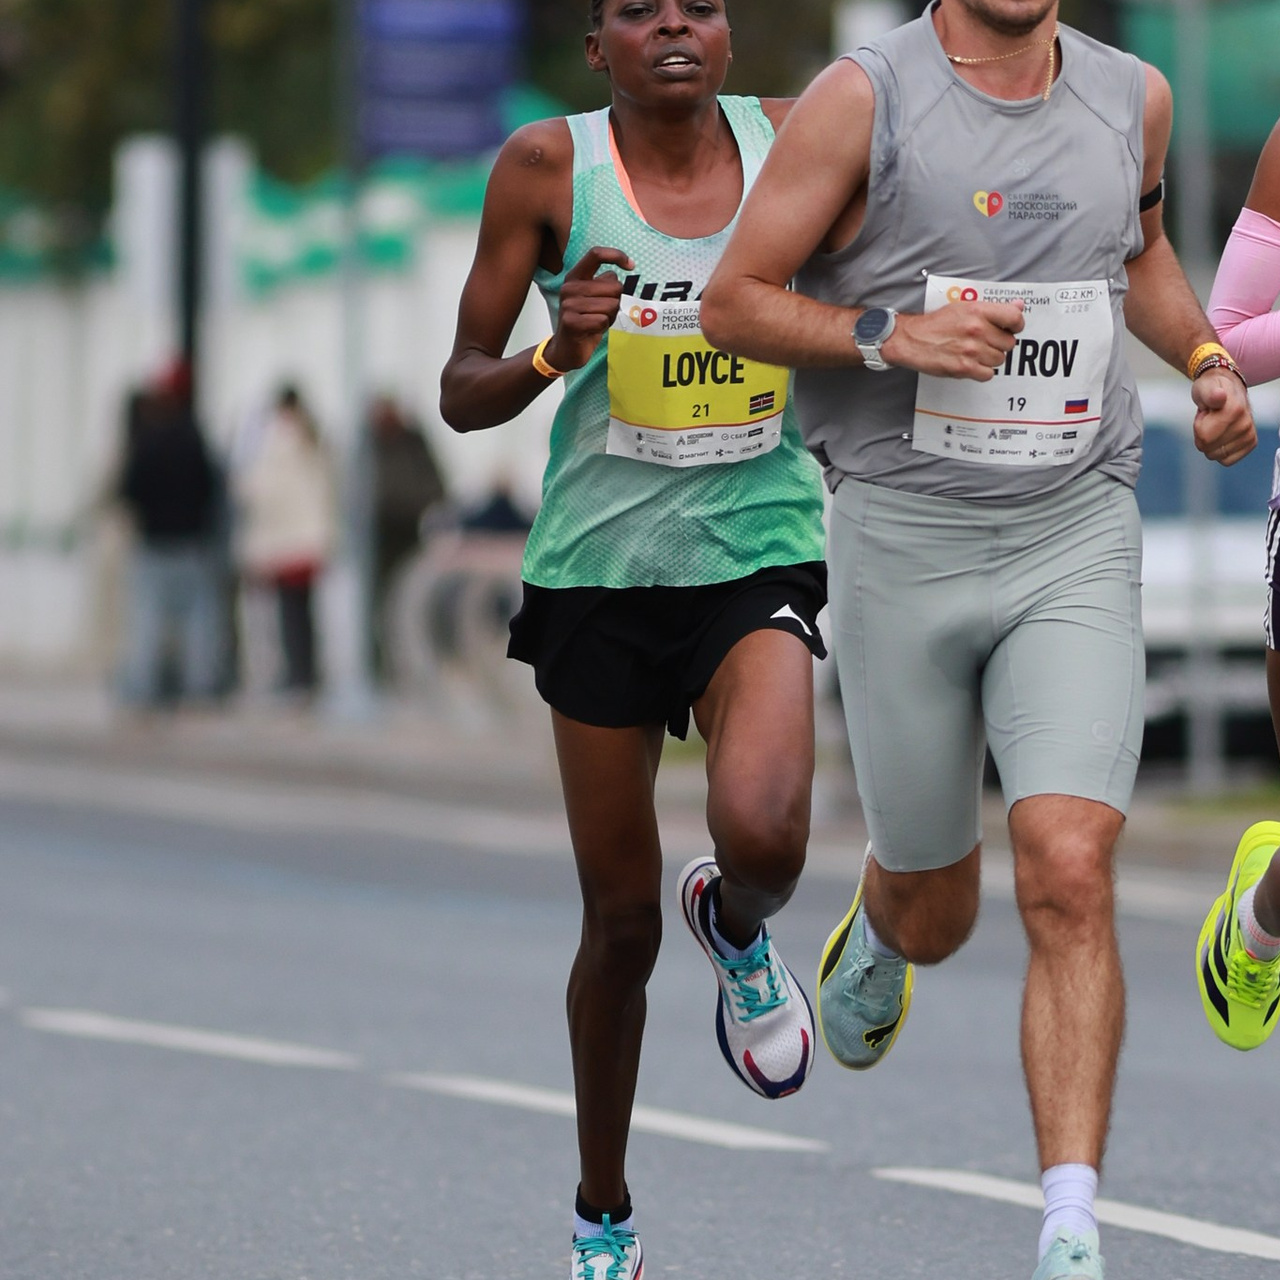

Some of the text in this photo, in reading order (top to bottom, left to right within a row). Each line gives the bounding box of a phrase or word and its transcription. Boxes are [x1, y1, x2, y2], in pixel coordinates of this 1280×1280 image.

[1008, 201, 1077, 211] МОСКОВСКИЙ
[1008, 211, 1059, 220] МАРАФОН
[984, 288, 1033, 296] СБЕРПРАЙМ
[1059, 291, 1078, 300] 42,2
[983, 296, 1050, 305] МОСКСКИЙ
[993, 339, 1079, 377] TROV
[662, 351, 744, 388] LOYCE
[1008, 397, 1026, 411] 19
[692, 404, 710, 418] 21
